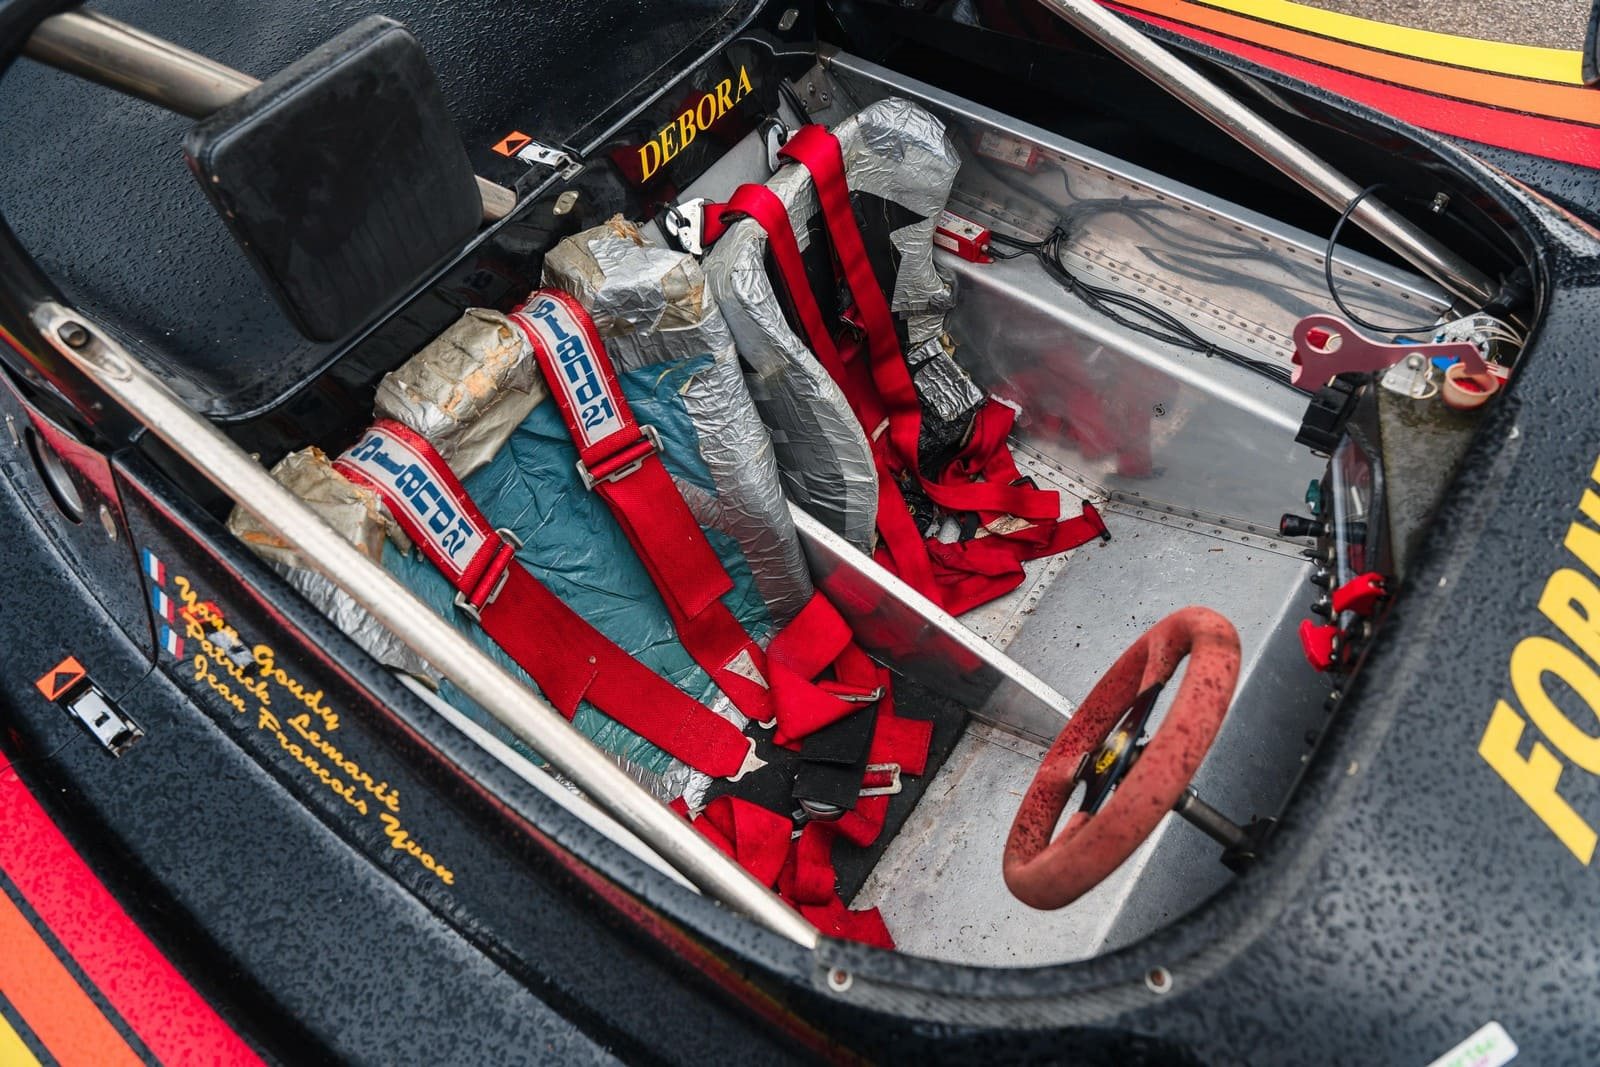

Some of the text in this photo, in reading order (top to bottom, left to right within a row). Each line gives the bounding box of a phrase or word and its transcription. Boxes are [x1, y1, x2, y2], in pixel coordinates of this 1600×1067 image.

[638, 65, 754, 183] DEBORA
[182, 613, 271, 705] Patrick
[194, 654, 246, 713] Jean
[253, 644, 340, 731] Goudy
